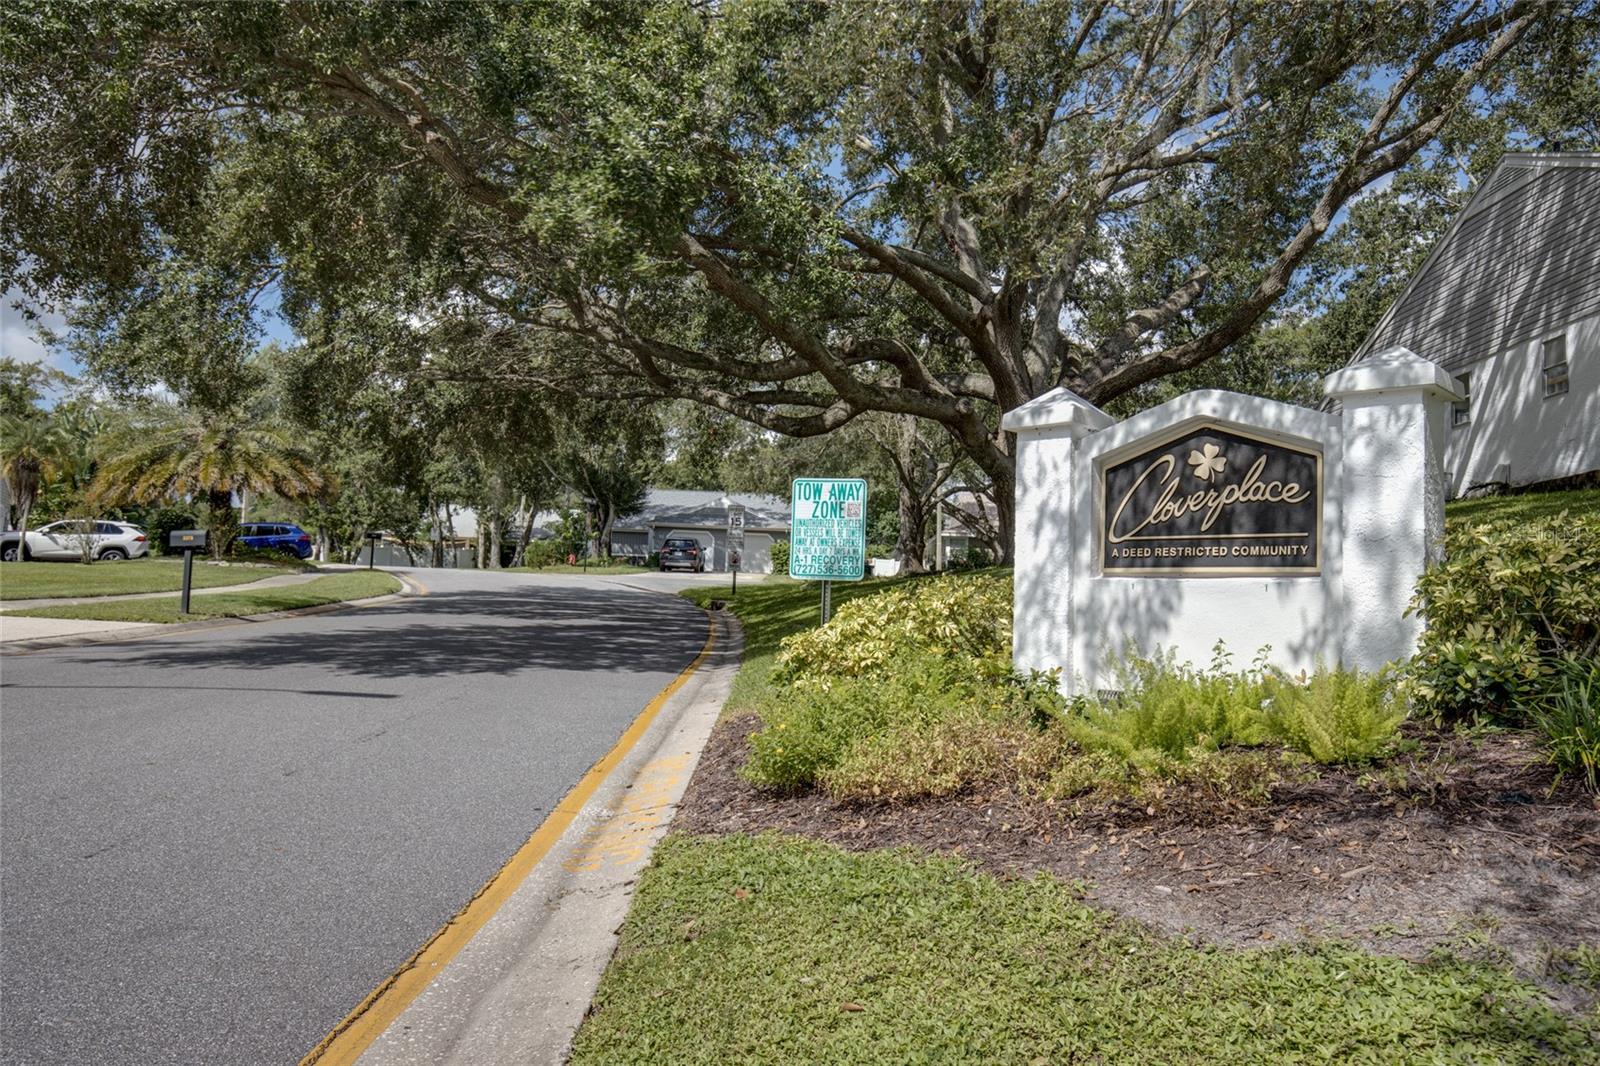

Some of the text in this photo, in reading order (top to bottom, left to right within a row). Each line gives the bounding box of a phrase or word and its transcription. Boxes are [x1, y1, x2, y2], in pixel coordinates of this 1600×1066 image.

[797, 483, 862, 501] TOW AWAY
[1108, 454, 1310, 544] Cloverplace
[811, 501, 845, 519] ZONE
[731, 517, 742, 526] 15
[795, 519, 862, 528] UNAUTHORIZED VEHICLES
[803, 528, 824, 537] VESSELS
[837, 529, 844, 538] BE
[838, 538, 861, 547] EXPENSE
[1111, 545, 1309, 558] A DEED RESTRICTED COMMUNITY
[794, 555, 861, 565] A-1 RECOVERY
[793, 564, 860, 575] (727)536-5600
